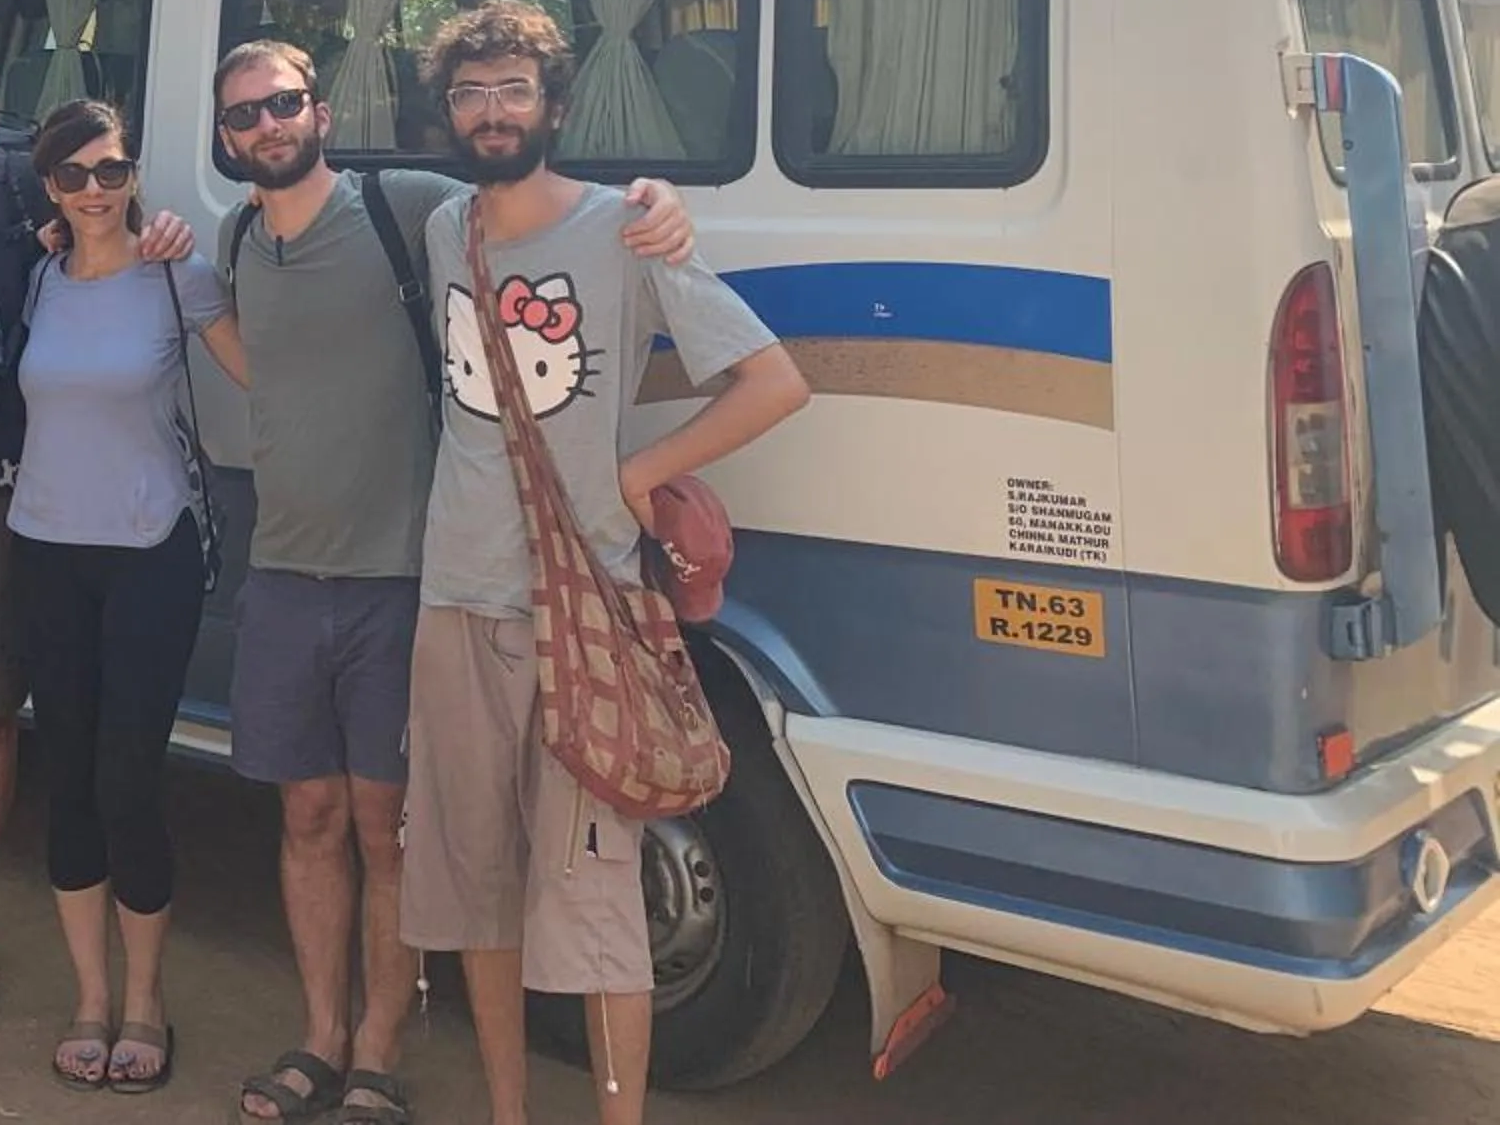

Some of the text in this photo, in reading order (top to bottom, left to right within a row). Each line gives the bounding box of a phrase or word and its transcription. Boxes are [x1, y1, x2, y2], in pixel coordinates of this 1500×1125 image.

[1031, 505, 1112, 522] SHANMUGAM
[1009, 529, 1054, 542] CHINNA
[1009, 542, 1077, 558] KARAIKUDI
[995, 588, 1085, 618] TN.63
[989, 617, 1092, 646] R.1229
